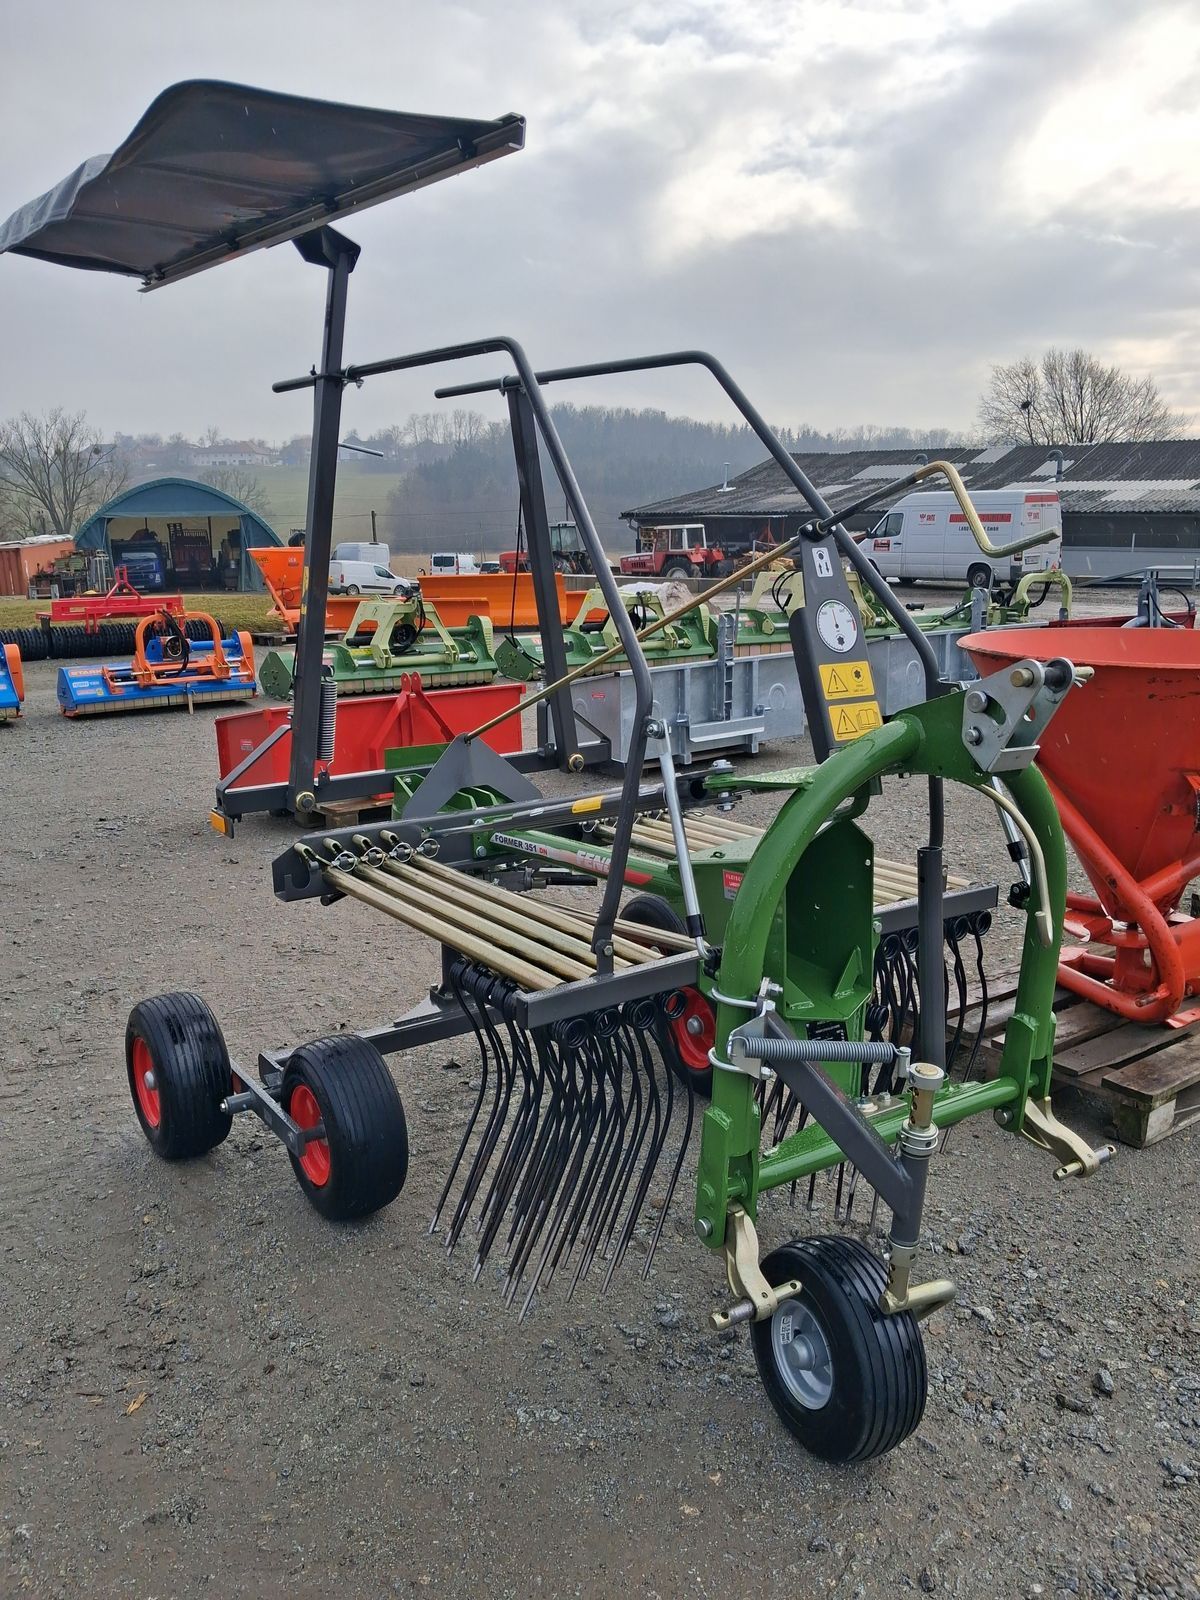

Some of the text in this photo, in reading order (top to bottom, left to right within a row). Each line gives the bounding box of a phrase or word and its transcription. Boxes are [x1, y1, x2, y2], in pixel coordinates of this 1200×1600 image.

[494, 834, 548, 855] FORMER 351 DN
